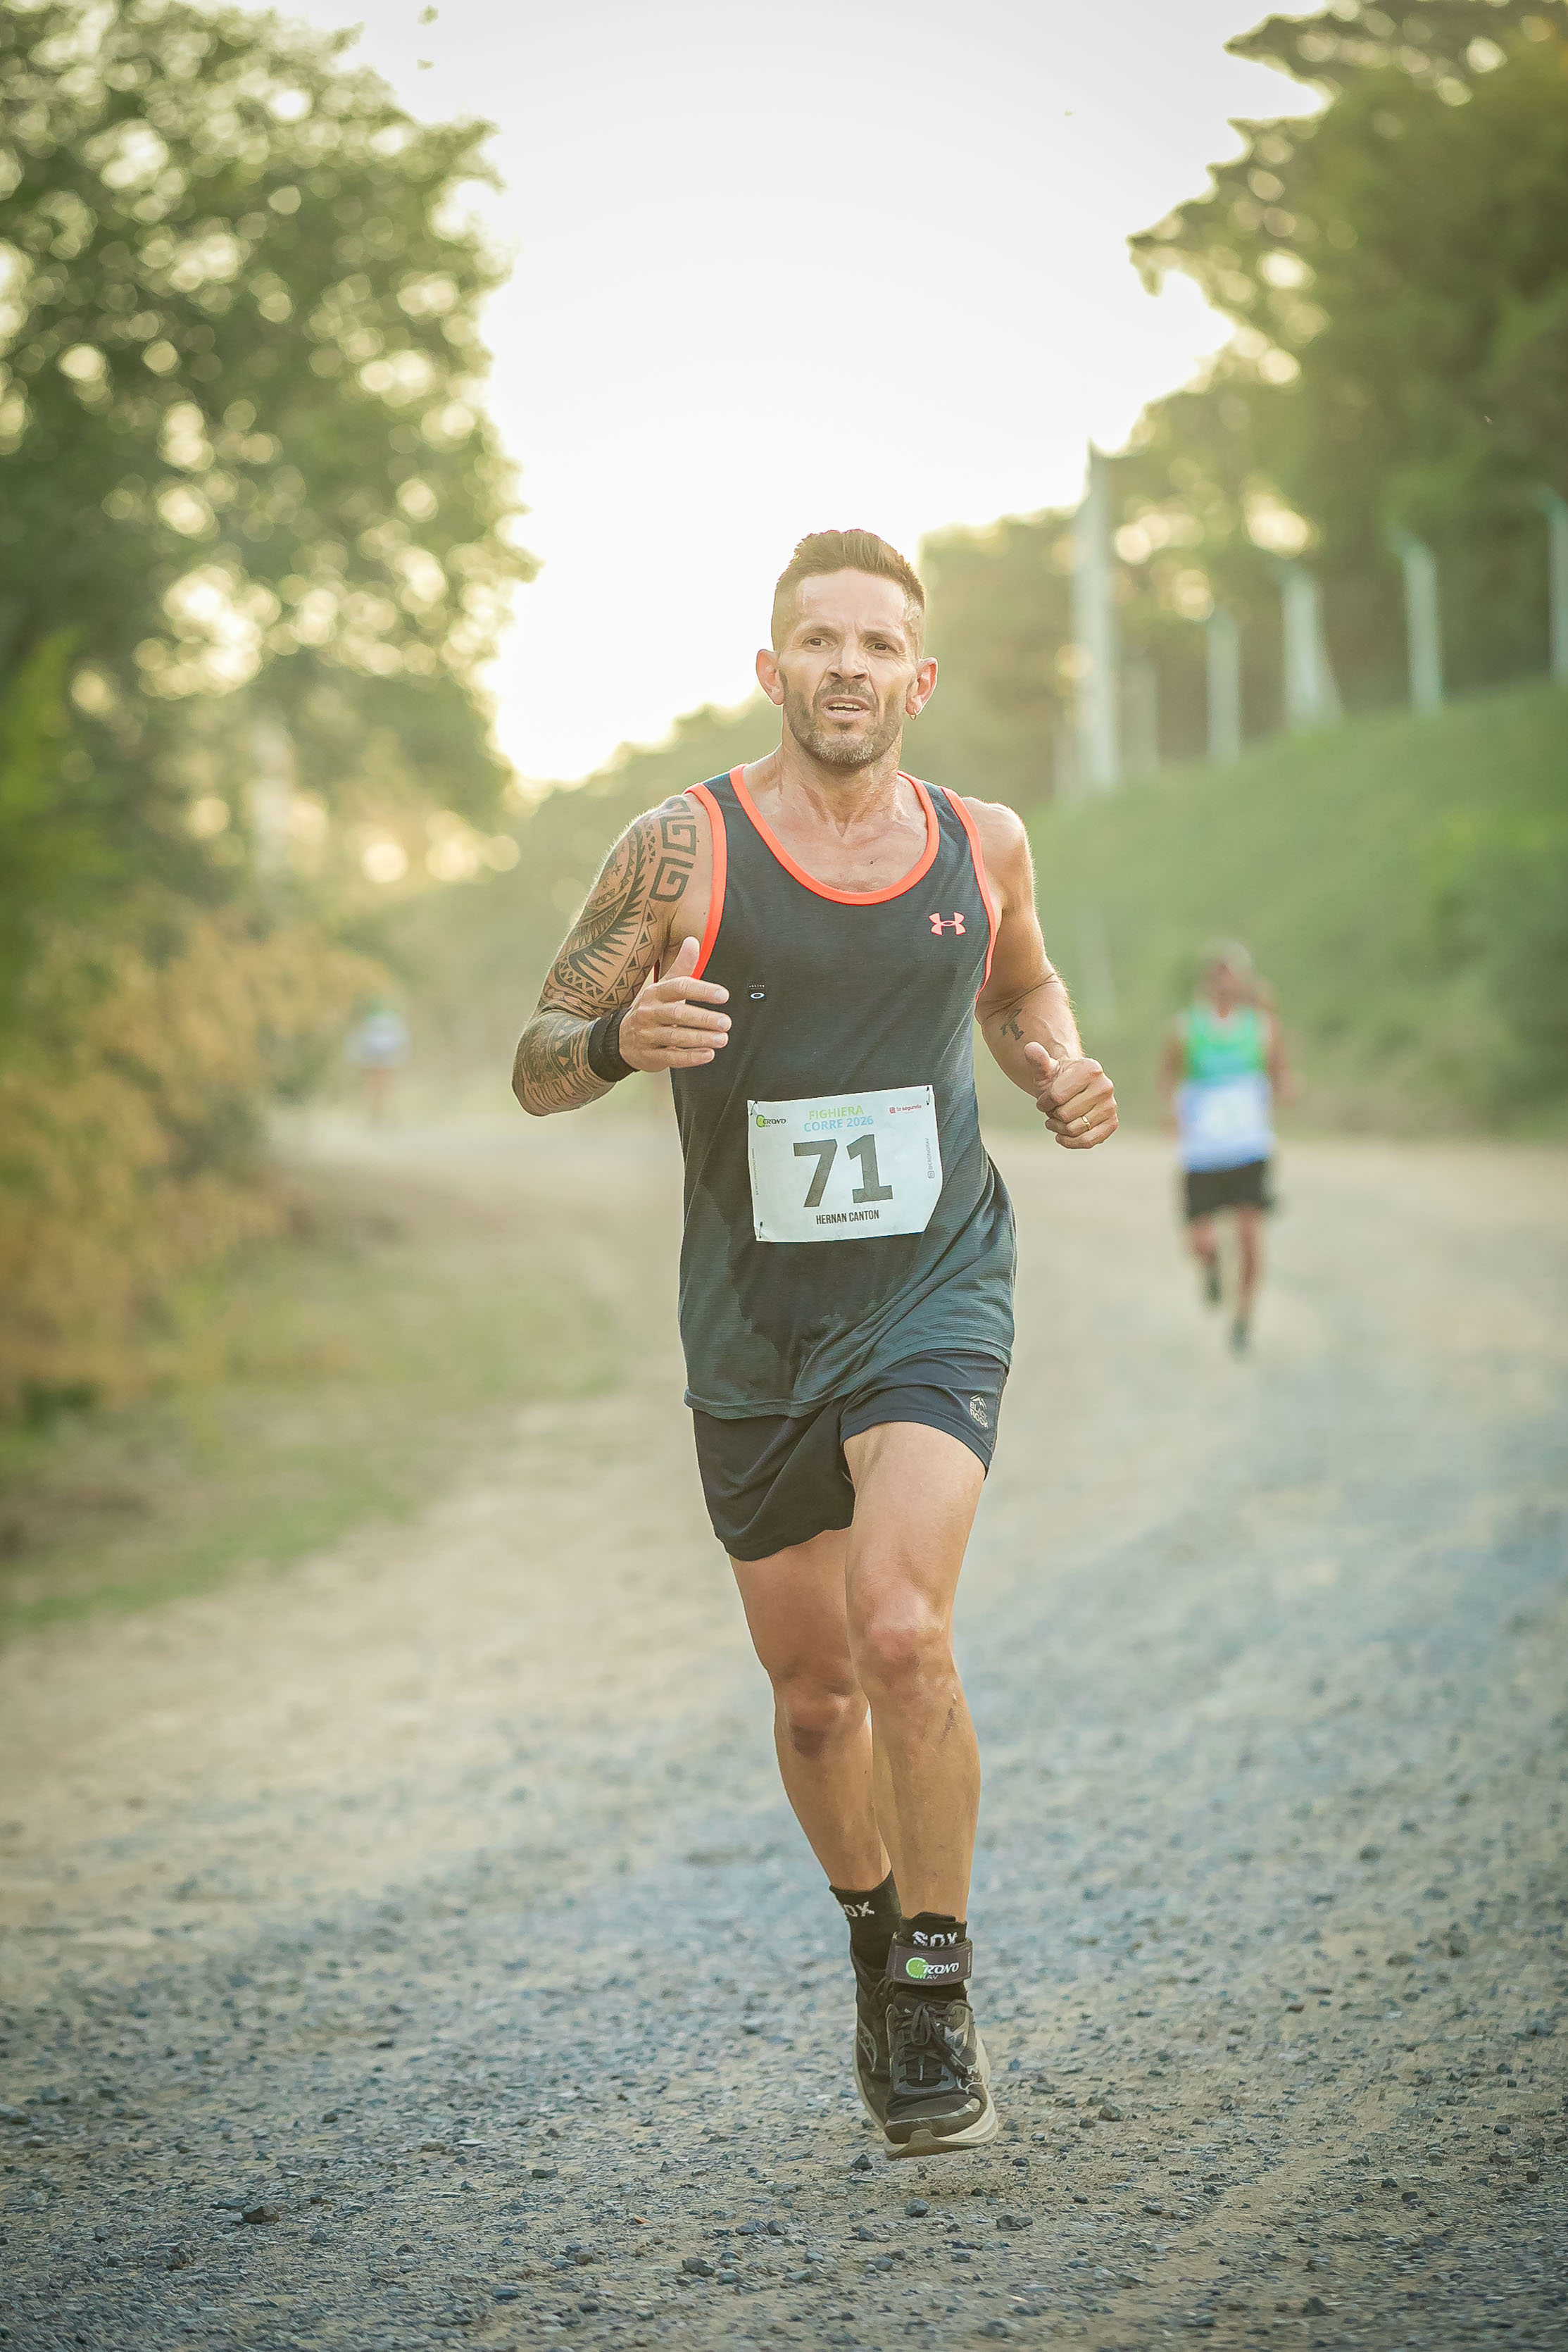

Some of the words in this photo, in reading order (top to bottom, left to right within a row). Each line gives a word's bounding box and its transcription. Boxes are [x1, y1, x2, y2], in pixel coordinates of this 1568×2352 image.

[809, 1105, 865, 1120] FIGHIERA
[803, 1118, 843, 1132] CORRE
[846, 1115, 874, 1127] 2026
[793, 1134, 893, 1207] 71
[816, 1213, 847, 1225] HERNAN
[848, 1209, 879, 1222] CANTON
